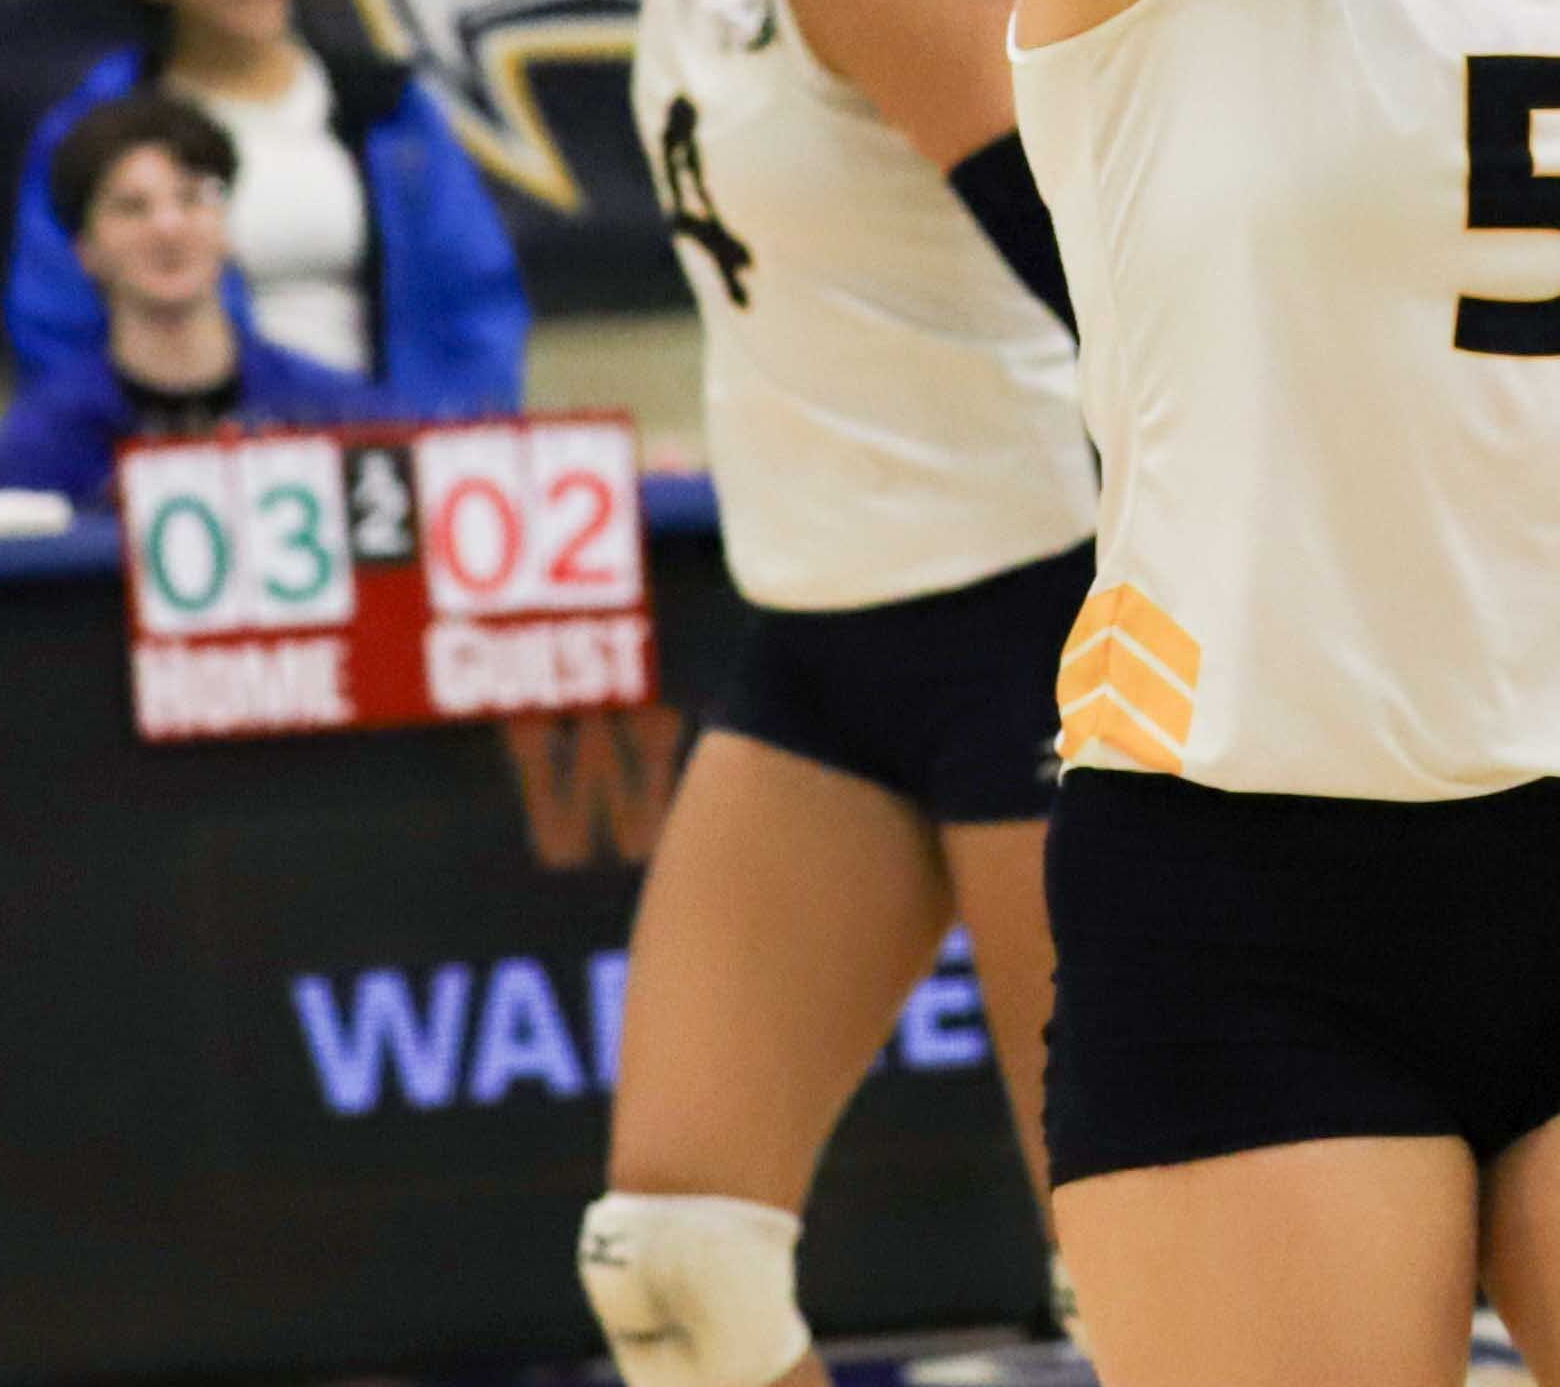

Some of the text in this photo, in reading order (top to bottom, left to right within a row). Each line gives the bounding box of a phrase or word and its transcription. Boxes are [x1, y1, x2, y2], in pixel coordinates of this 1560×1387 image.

[146, 481, 335, 615] 03
[428, 467, 618, 595] 02
[424, 615, 652, 715] GUEST
